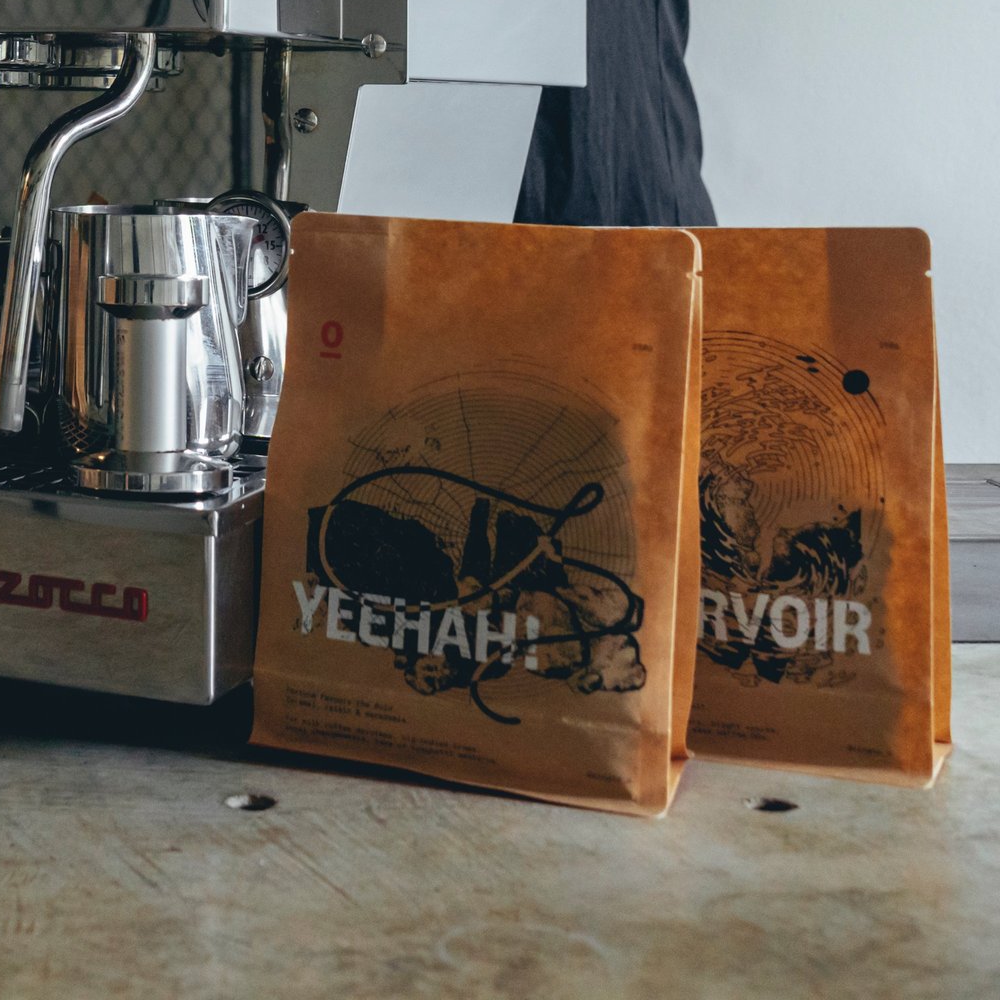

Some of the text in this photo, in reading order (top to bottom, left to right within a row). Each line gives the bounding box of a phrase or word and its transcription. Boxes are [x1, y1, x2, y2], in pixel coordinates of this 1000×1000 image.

[258, 224, 267, 234] 12
[265, 241, 275, 250] 15
[292, 580, 540, 671] YEEHAH!
